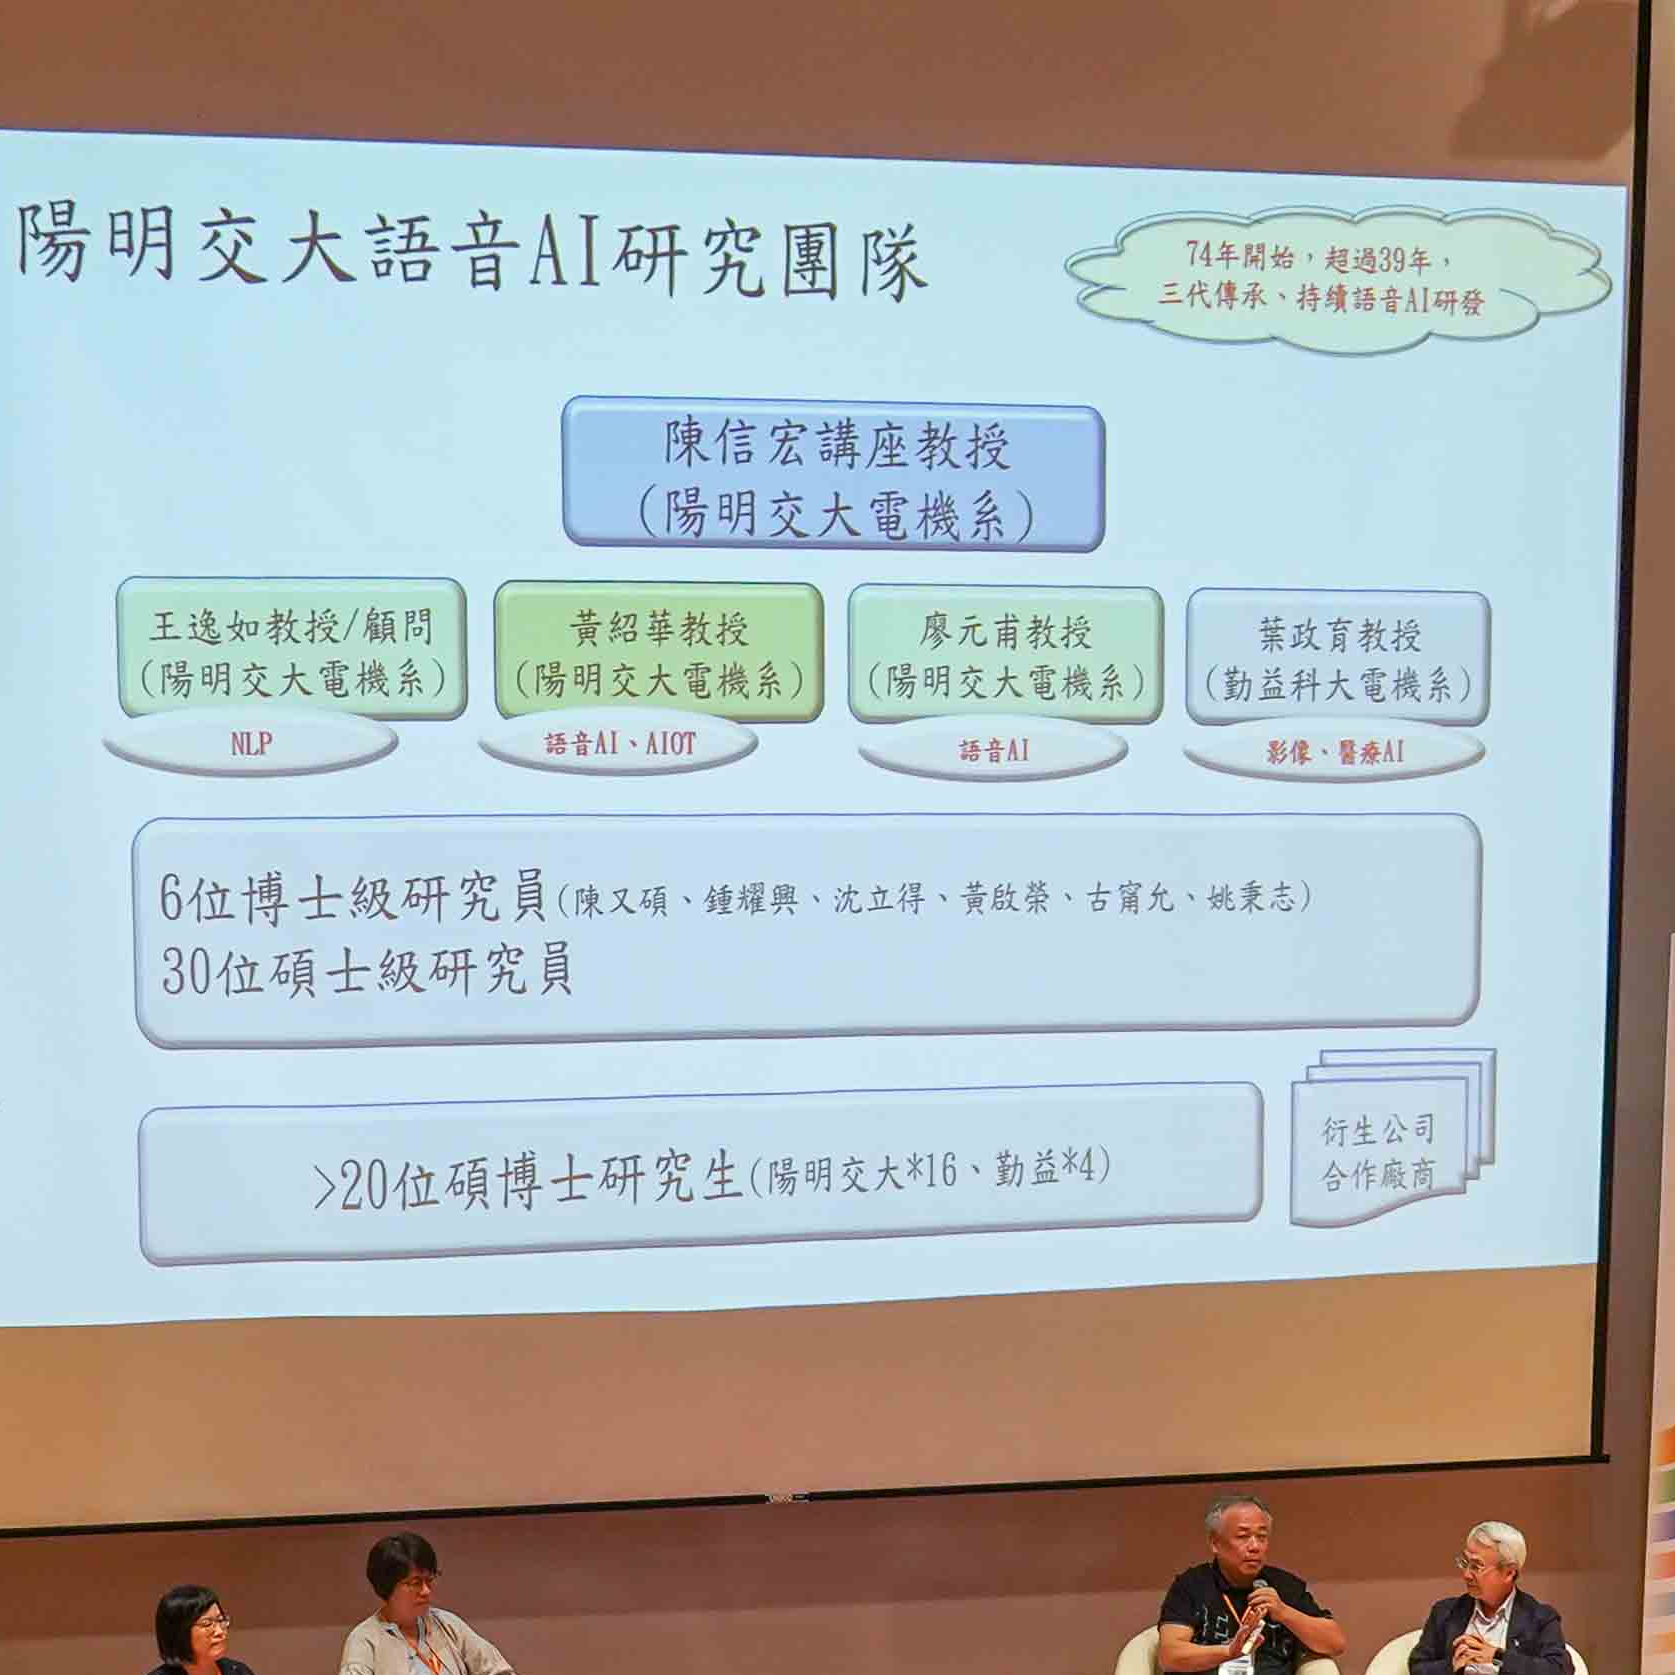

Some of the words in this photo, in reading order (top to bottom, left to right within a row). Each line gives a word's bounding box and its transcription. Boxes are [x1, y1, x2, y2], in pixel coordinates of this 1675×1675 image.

[17, 198, 930, 304] 陽明交大語音AI研究團隊
[664, 418, 1012, 472] 陳信宏講座教授
[147, 606, 433, 647] 王逸如教授/顧問
[569, 608, 750, 648] 黃紹華教授
[919, 610, 1093, 651] 廖元甫教授
[1258, 615, 1422, 654] 葉政育教授
[231, 730, 273, 756] NLP
[958, 737, 1029, 764] 語音AI
[162, 940, 572, 999] 30位碩士級研究員
[1324, 1112, 1436, 1148] 衍生公司
[1322, 1157, 1436, 1192] 合作廠商
